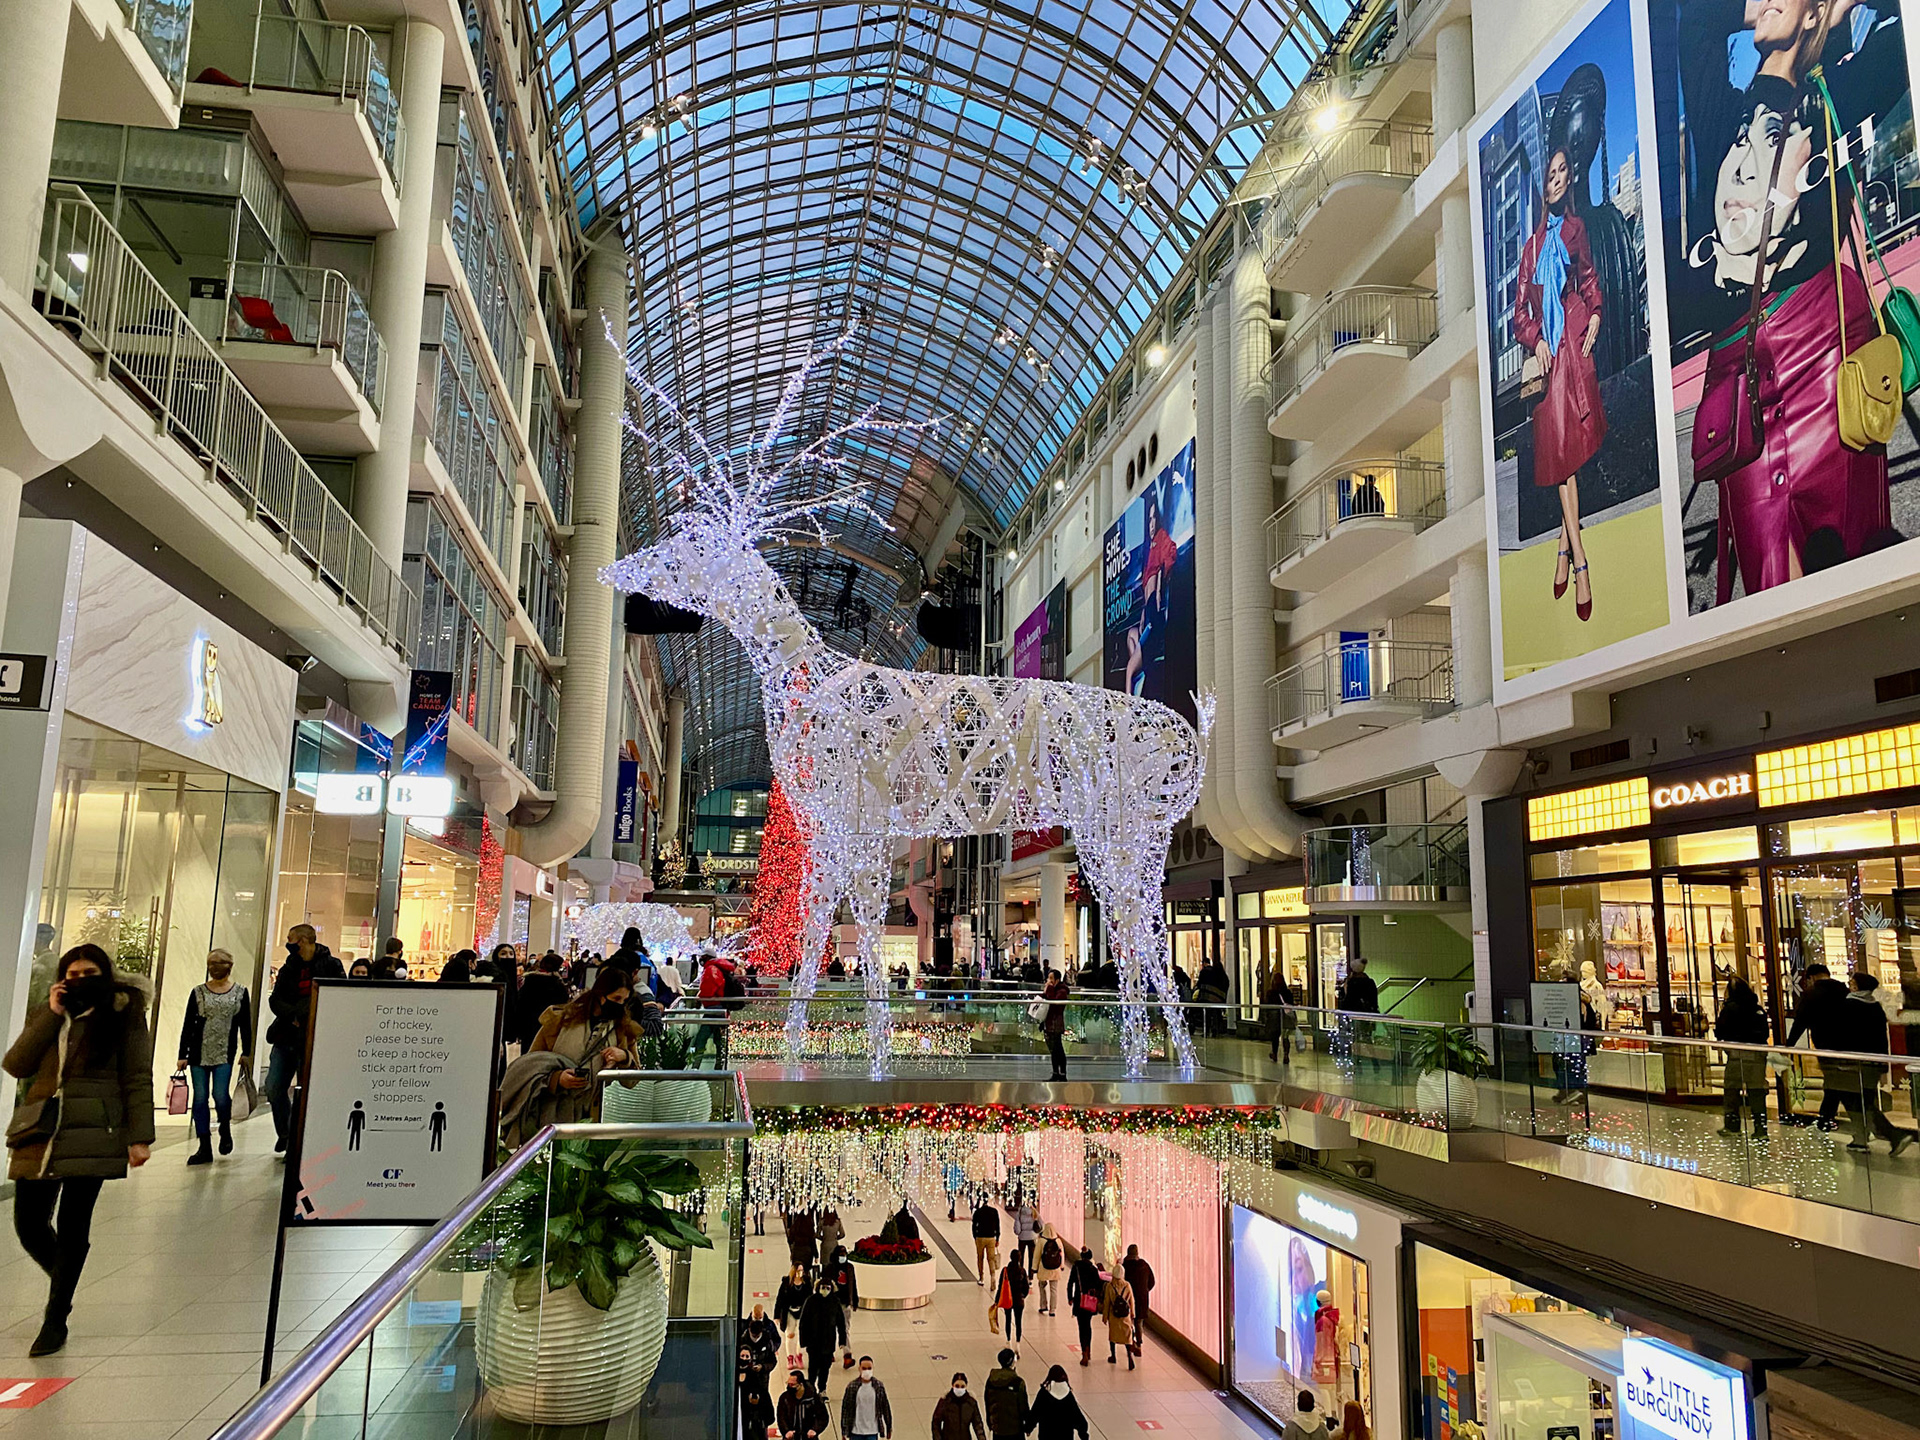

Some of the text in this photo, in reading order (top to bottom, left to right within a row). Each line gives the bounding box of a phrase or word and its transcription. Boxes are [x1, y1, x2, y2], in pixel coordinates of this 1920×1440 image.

[1688, 112, 1878, 269] COACH
[1106, 531, 1121, 563] SHE
[1106, 547, 1131, 585] MOVES
[1106, 576, 1121, 606] THE
[1106, 589, 1132, 628] CROWD
[1350, 681, 1362, 692] P1
[412, 702, 446, 711] CANADA
[1652, 773, 1752, 809] COACH
[617, 786, 633, 840] Indigo Books
[376, 1005, 439, 1016] For the love
[379, 1020, 391, 1030] of
[365, 1034, 444, 1045] please be sure
[357, 1049, 450, 1061] to keep a hockey
[361, 1063, 443, 1074] stick apart from
[371, 1078, 431, 1089] your fellow
[373, 1093, 426, 1104] shoppers.
[403, 1115, 422, 1123] Apart
[382, 1168, 404, 1180] CF
[1660, 1376, 1712, 1418] LITTLE
[1626, 1381, 1712, 1440] BURGUNDY
